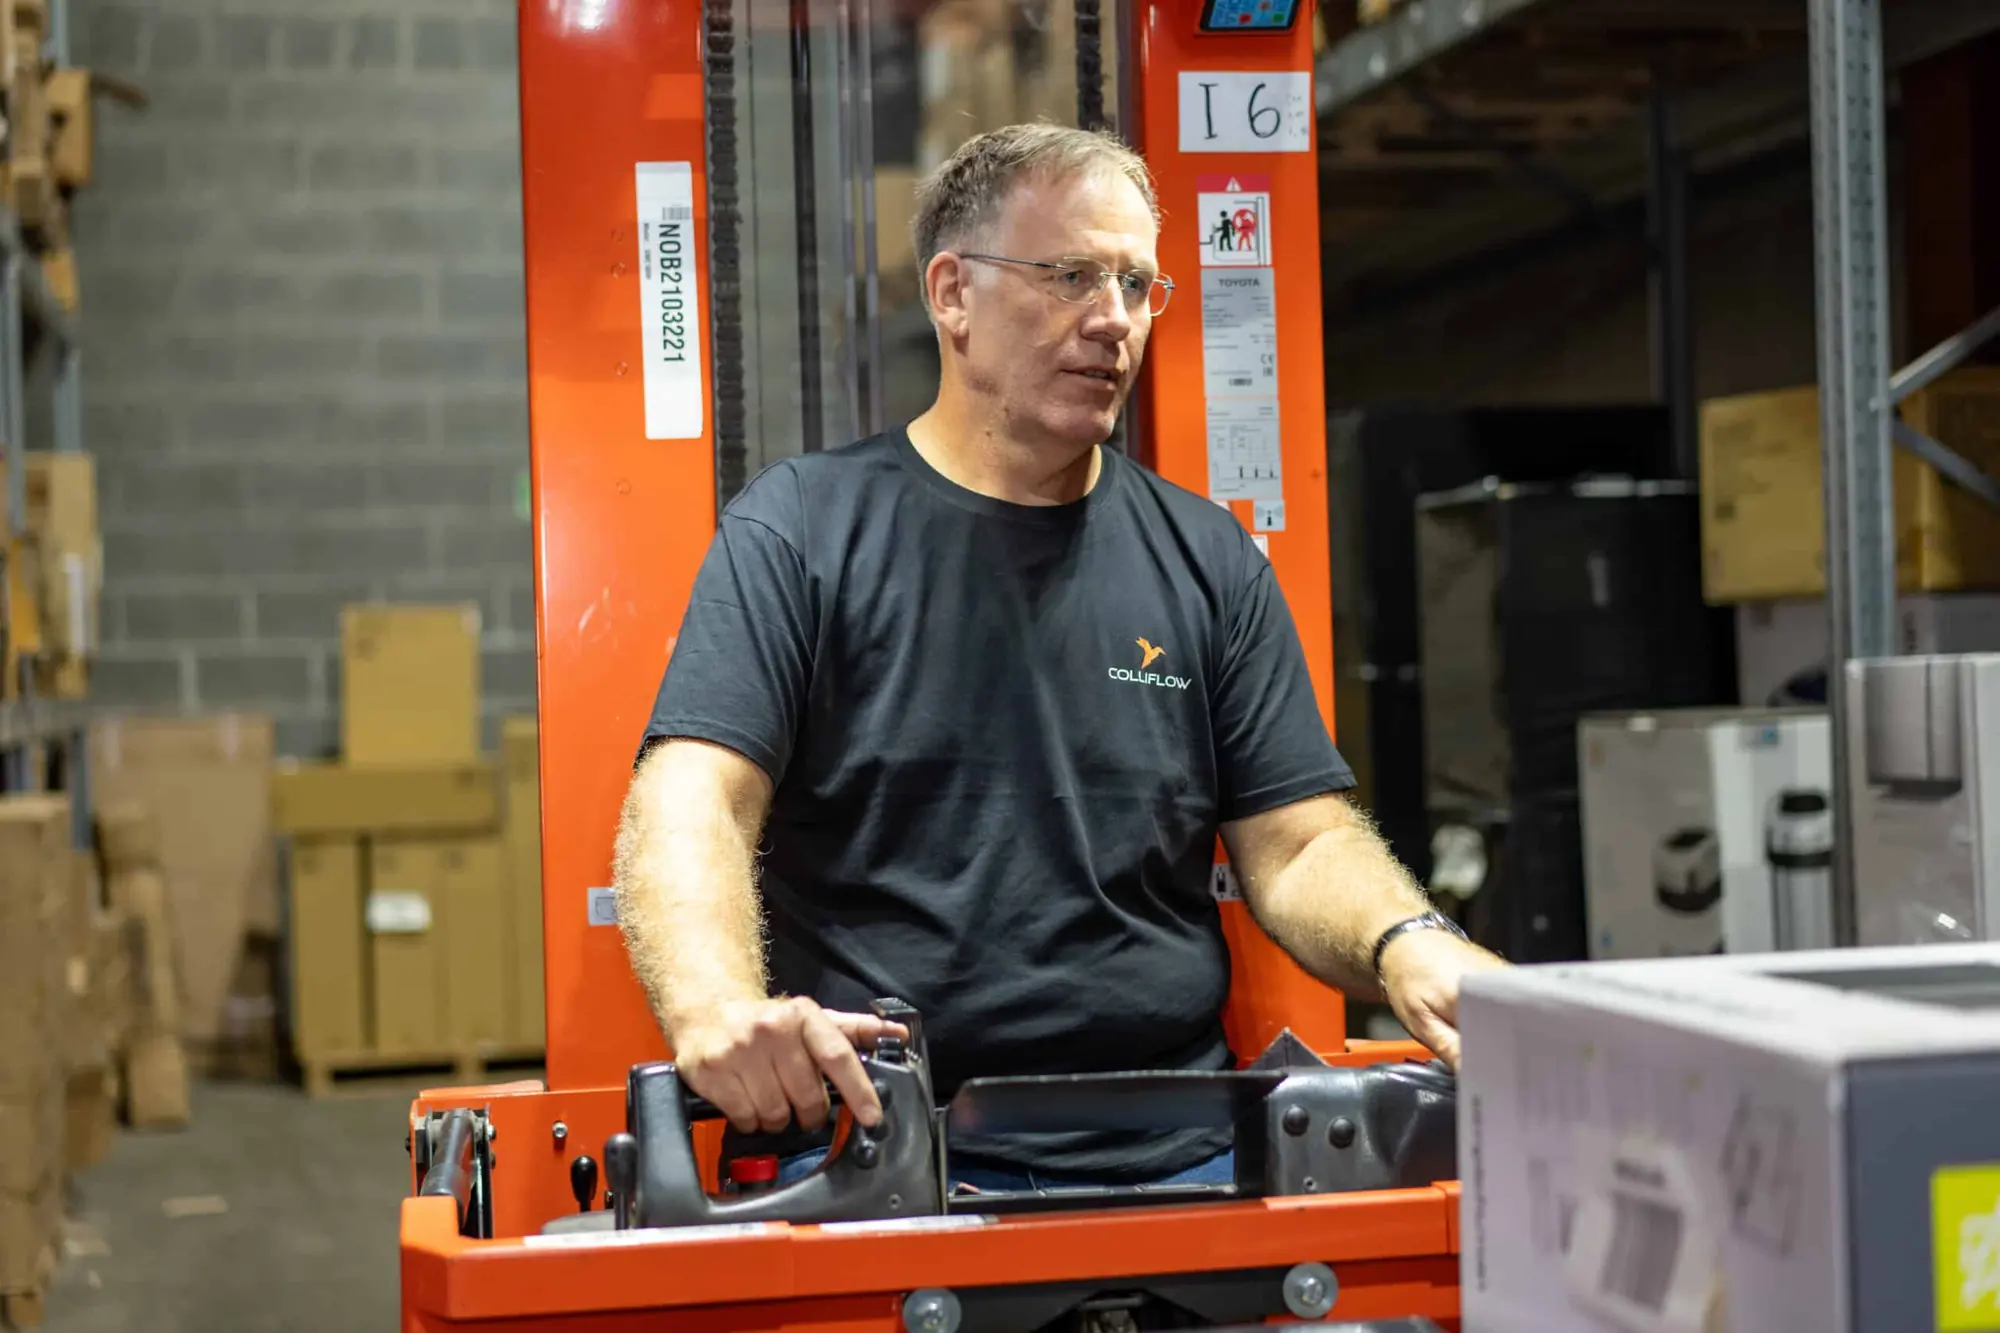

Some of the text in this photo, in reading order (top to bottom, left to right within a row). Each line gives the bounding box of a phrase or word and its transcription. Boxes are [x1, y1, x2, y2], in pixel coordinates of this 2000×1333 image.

[658, 223, 686, 364] NOB2103221
[1218, 278, 1260, 288] TOYOTA
[1108, 667, 1192, 690] COLLIFLOW
